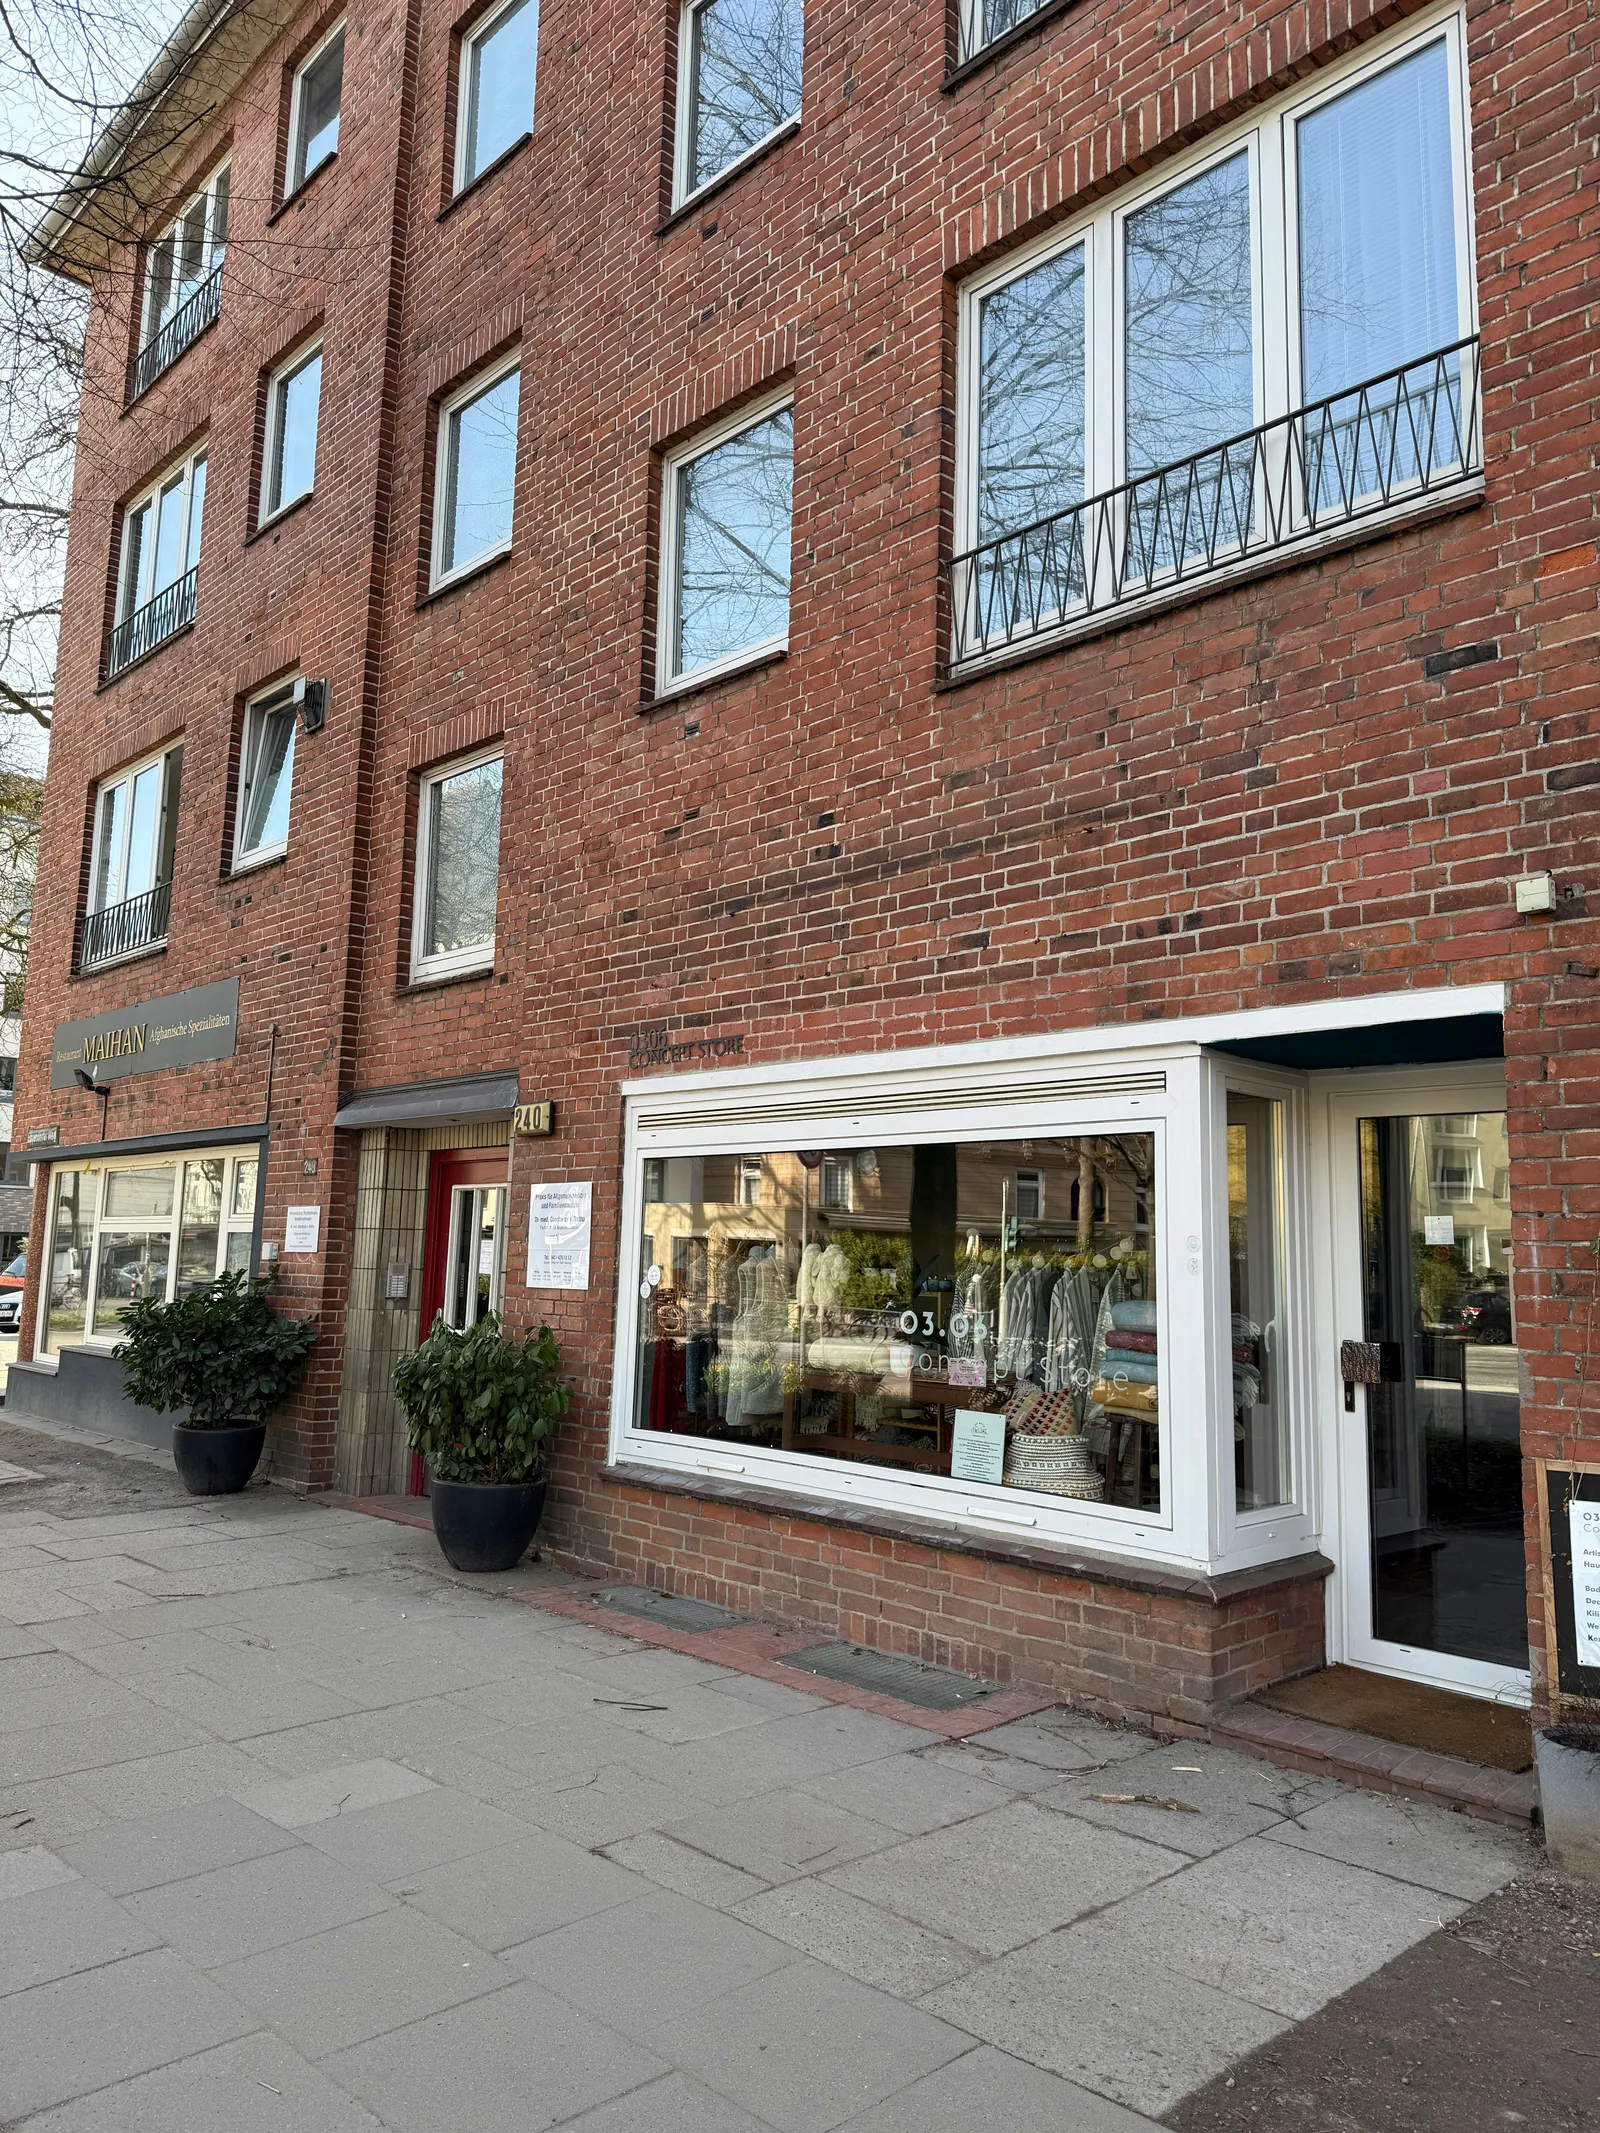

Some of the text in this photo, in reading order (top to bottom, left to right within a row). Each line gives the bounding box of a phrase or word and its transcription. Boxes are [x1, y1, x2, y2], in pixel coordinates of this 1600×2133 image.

[56, 1013, 231, 1064] Restaurant MAIHAN Afghanische Spezialitäten
[628, 1034, 745, 1070] CONCEPT STORE
[629, 1026, 668, 1052] 0306
[515, 1105, 542, 1131] 240
[900, 1309, 988, 1340] 03.06
[901, 1344, 1029, 1386] Concept
[1039, 1349, 1129, 1391] Store
[1583, 1523, 1600, 1534] Co
